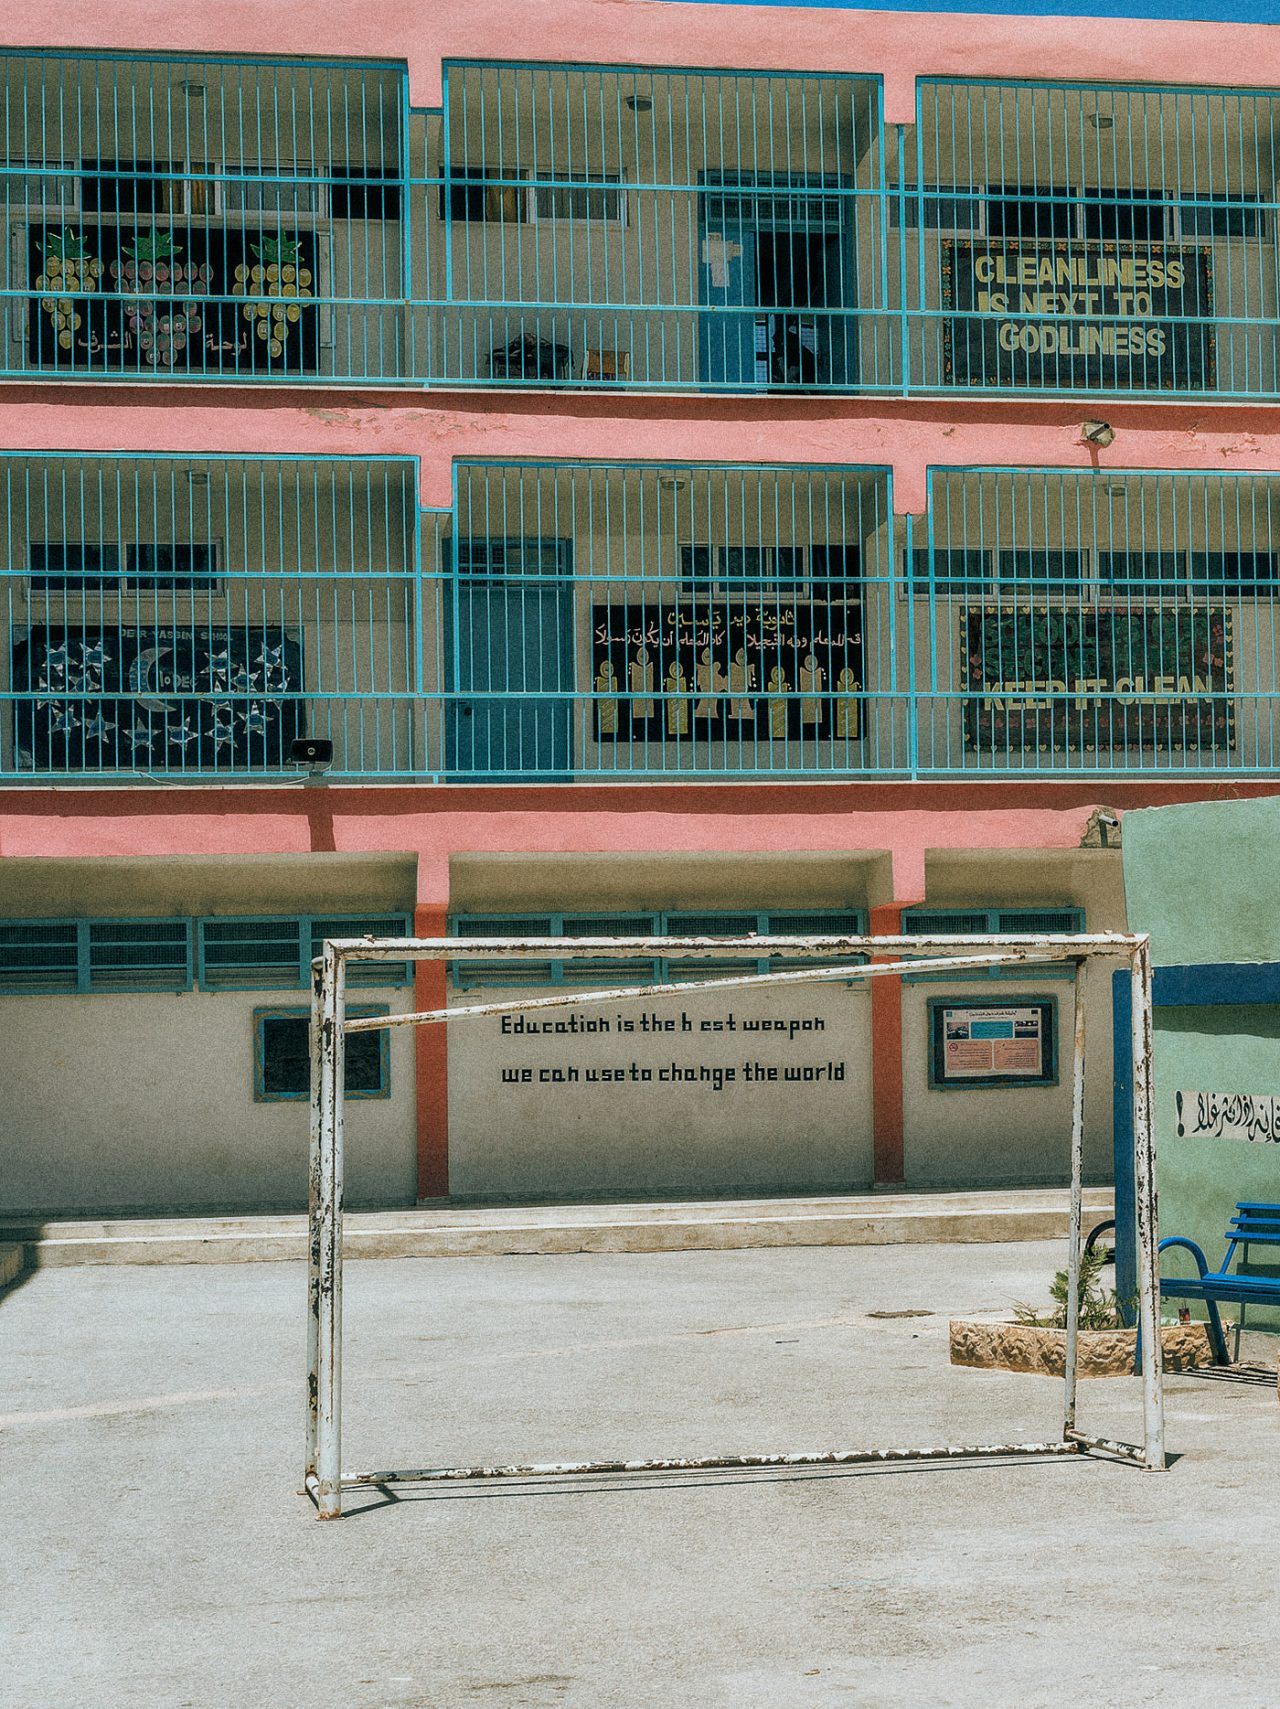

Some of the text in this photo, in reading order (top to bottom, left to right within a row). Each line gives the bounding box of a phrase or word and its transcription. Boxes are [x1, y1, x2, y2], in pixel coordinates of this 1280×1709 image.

[974, 255, 1186, 289] CLEANLINESS
[1019, 291, 1099, 320] NEXT
[1116, 291, 1154, 318] TO
[77, 330, 248, 356] لوحة الشرف
[999, 323, 1167, 357] GODLINESS
[983, 674, 1214, 712] KEEP IT CLEAN
[501, 1014, 610, 1034] Education
[617, 1015, 635, 1032] is
[640, 1013, 675, 1032] the
[743, 1017, 825, 1040] weapon
[502, 1062, 845, 1091] we can use to change the world
